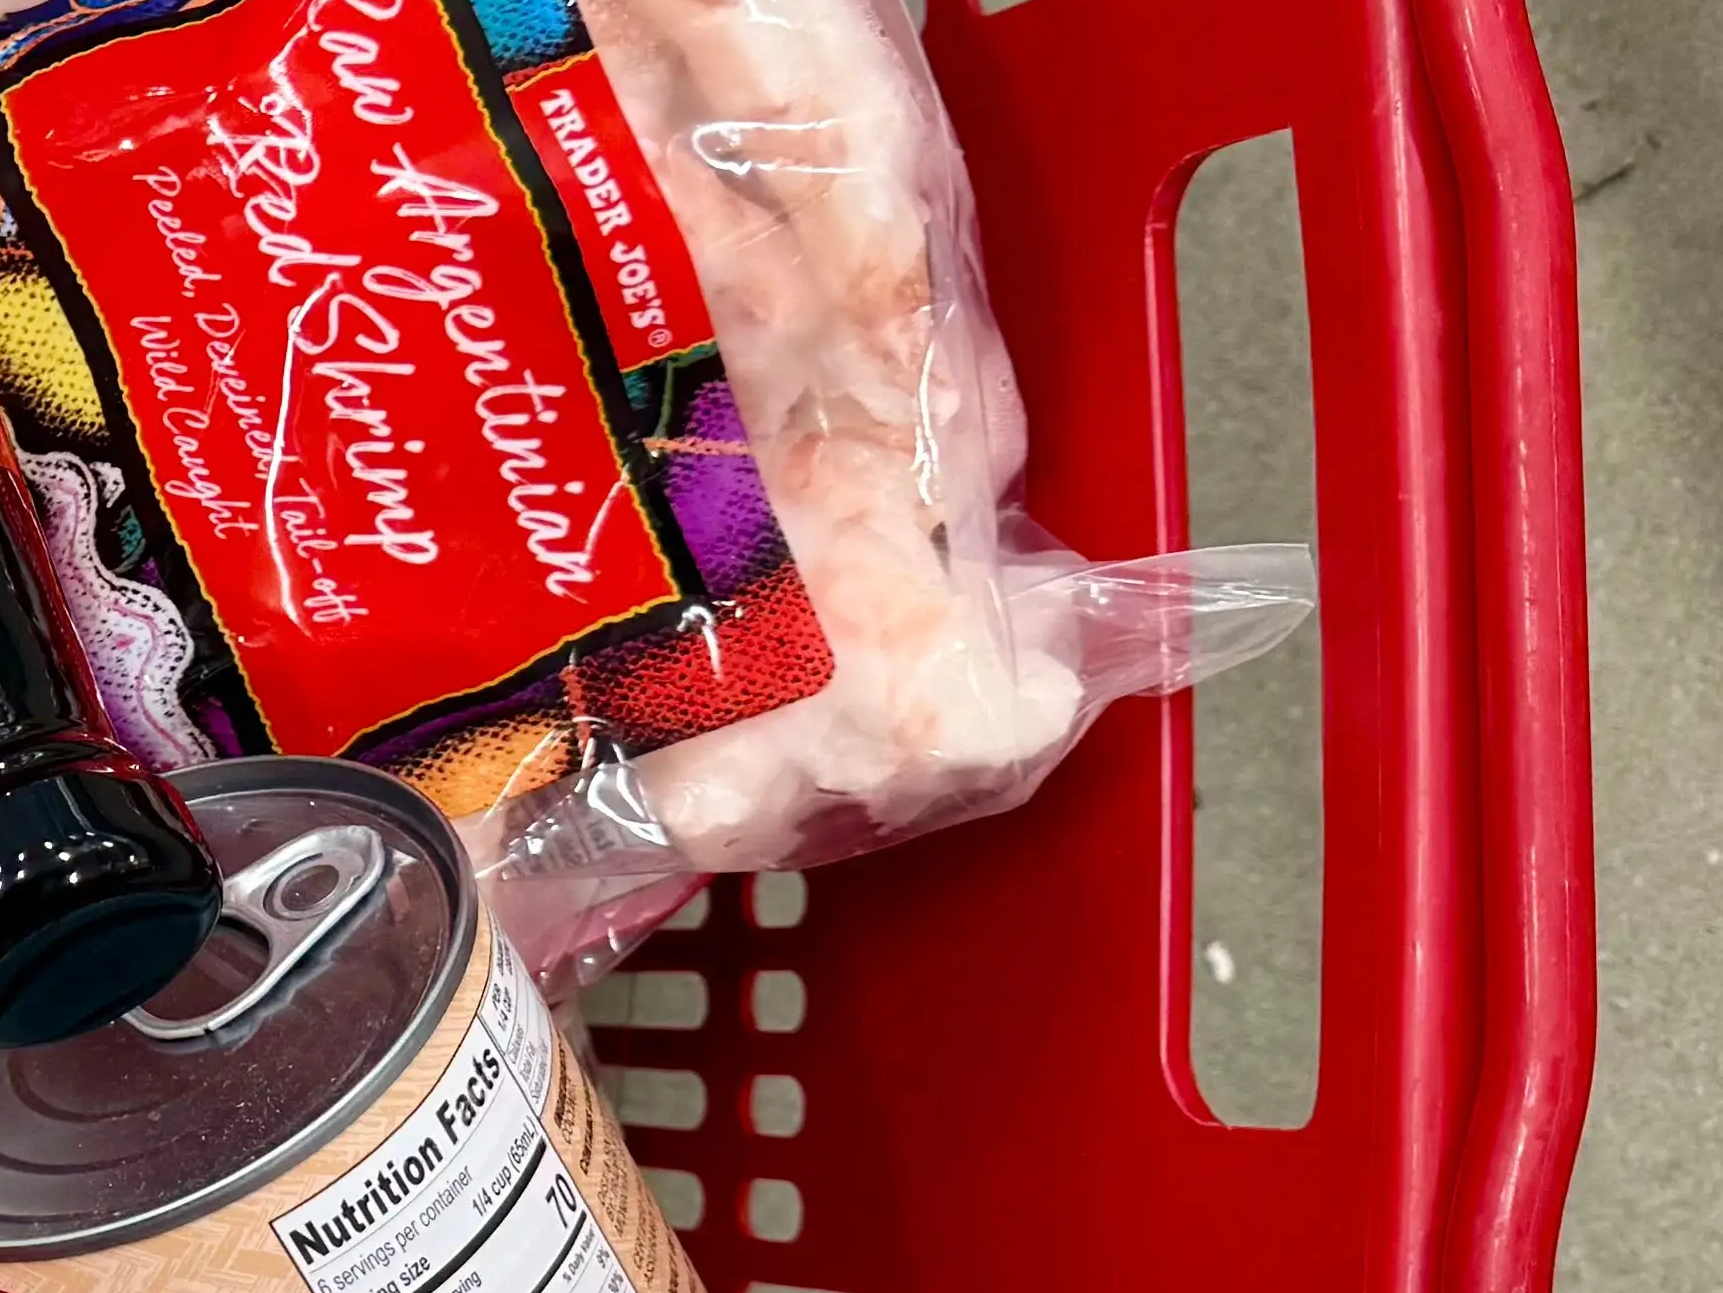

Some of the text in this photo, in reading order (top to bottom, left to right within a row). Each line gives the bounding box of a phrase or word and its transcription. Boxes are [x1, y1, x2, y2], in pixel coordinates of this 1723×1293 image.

[538, 88, 667, 330] TRADER JOE'S
[129, 315, 260, 540] Wild Caught
[132, 165, 369, 626] Peeled, Deveined, Tail-off
[206, 114, 440, 565] Red Shrimp
[362, 142, 594, 598] Argentinian
[289, 1047, 501, 1266] Nutrition Facts
[332, 1241, 397, 1292] servings
[394, 1220, 419, 1255] per
[418, 1165, 475, 1229] container
[402, 1254, 432, 1288] size
[471, 1190, 493, 1217] 1/4
[492, 1167, 514, 1197] cup
[510, 1114, 541, 1174] (65mL)
[545, 1172, 578, 1229] 70
